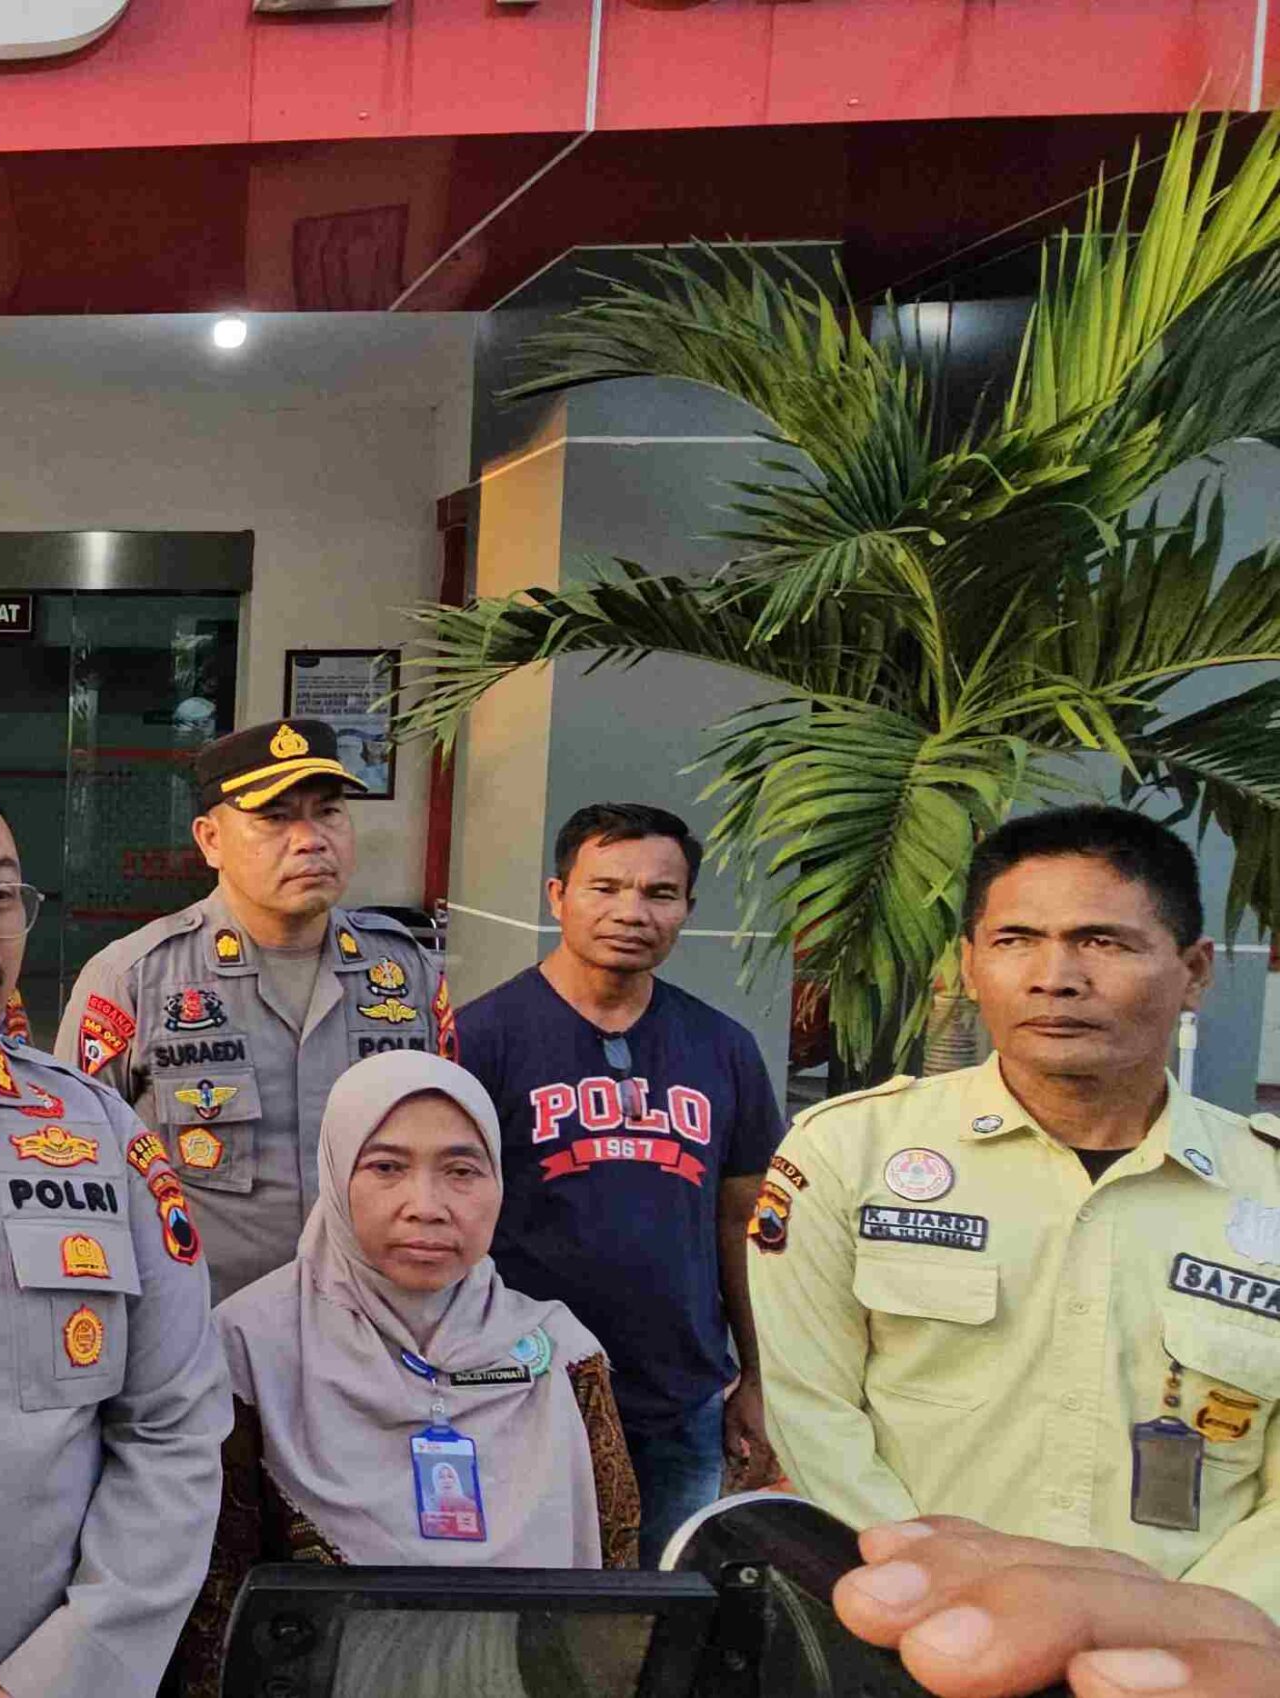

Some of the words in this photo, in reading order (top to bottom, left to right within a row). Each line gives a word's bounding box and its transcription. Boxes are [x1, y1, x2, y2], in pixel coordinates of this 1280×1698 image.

[530, 1076, 711, 1145] POLO
[592, 1138, 654, 1159] 1967
[771, 1156, 803, 1186] OLDA
[9, 1179, 118, 1214] POLRI
